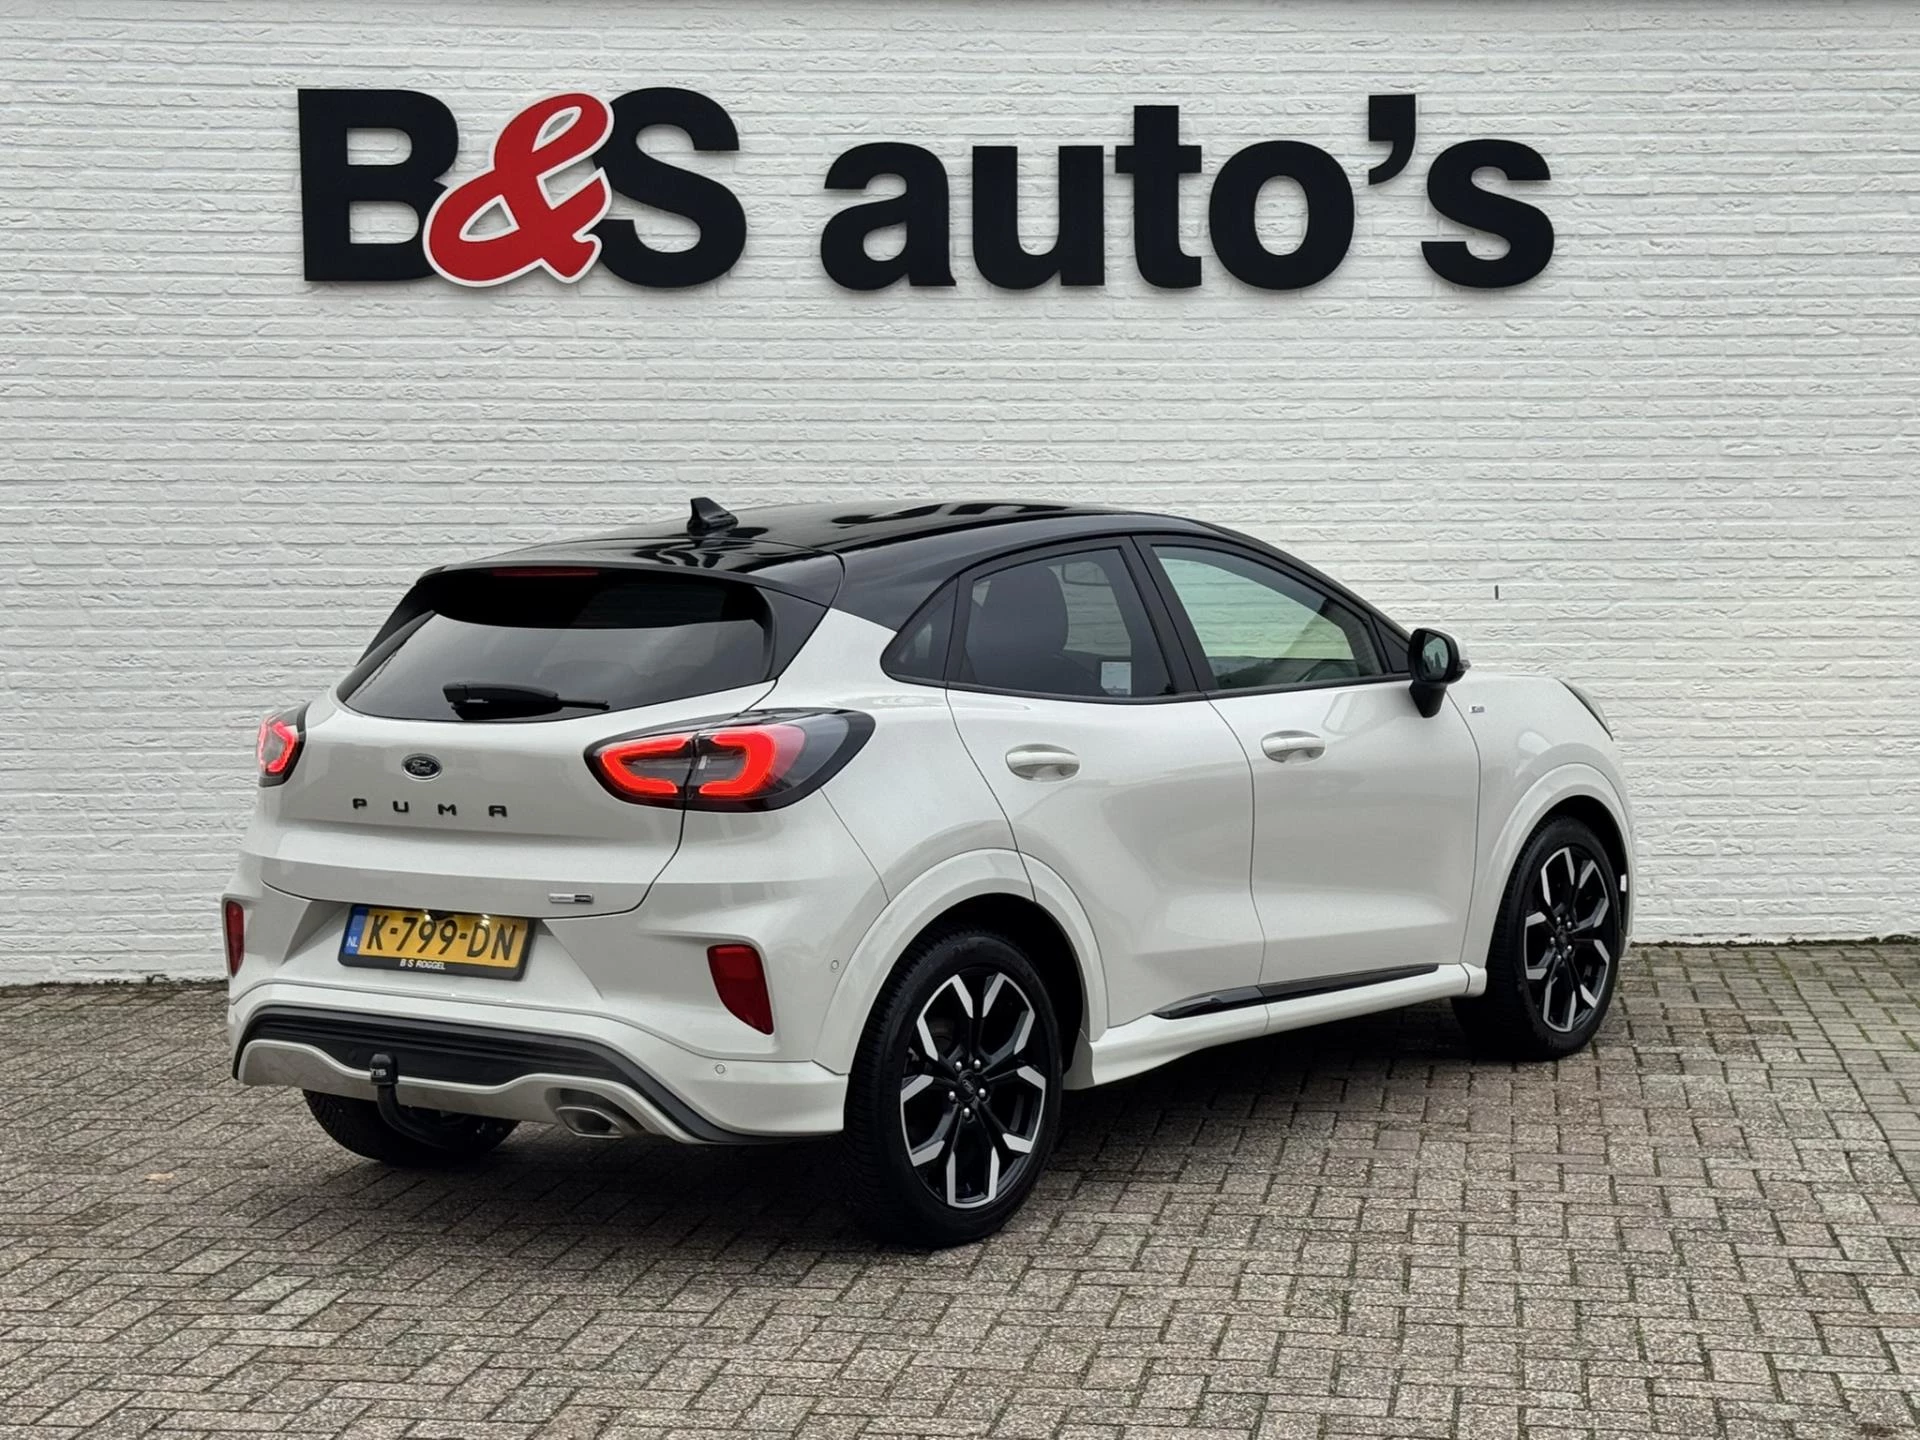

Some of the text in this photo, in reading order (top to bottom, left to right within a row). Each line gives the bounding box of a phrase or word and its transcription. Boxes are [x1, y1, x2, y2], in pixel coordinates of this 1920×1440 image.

[298, 87, 1555, 291] B&S auto's
[352, 798, 508, 817] PUMA
[347, 936, 358, 947] NL
[366, 914, 517, 961] K-799-DN
